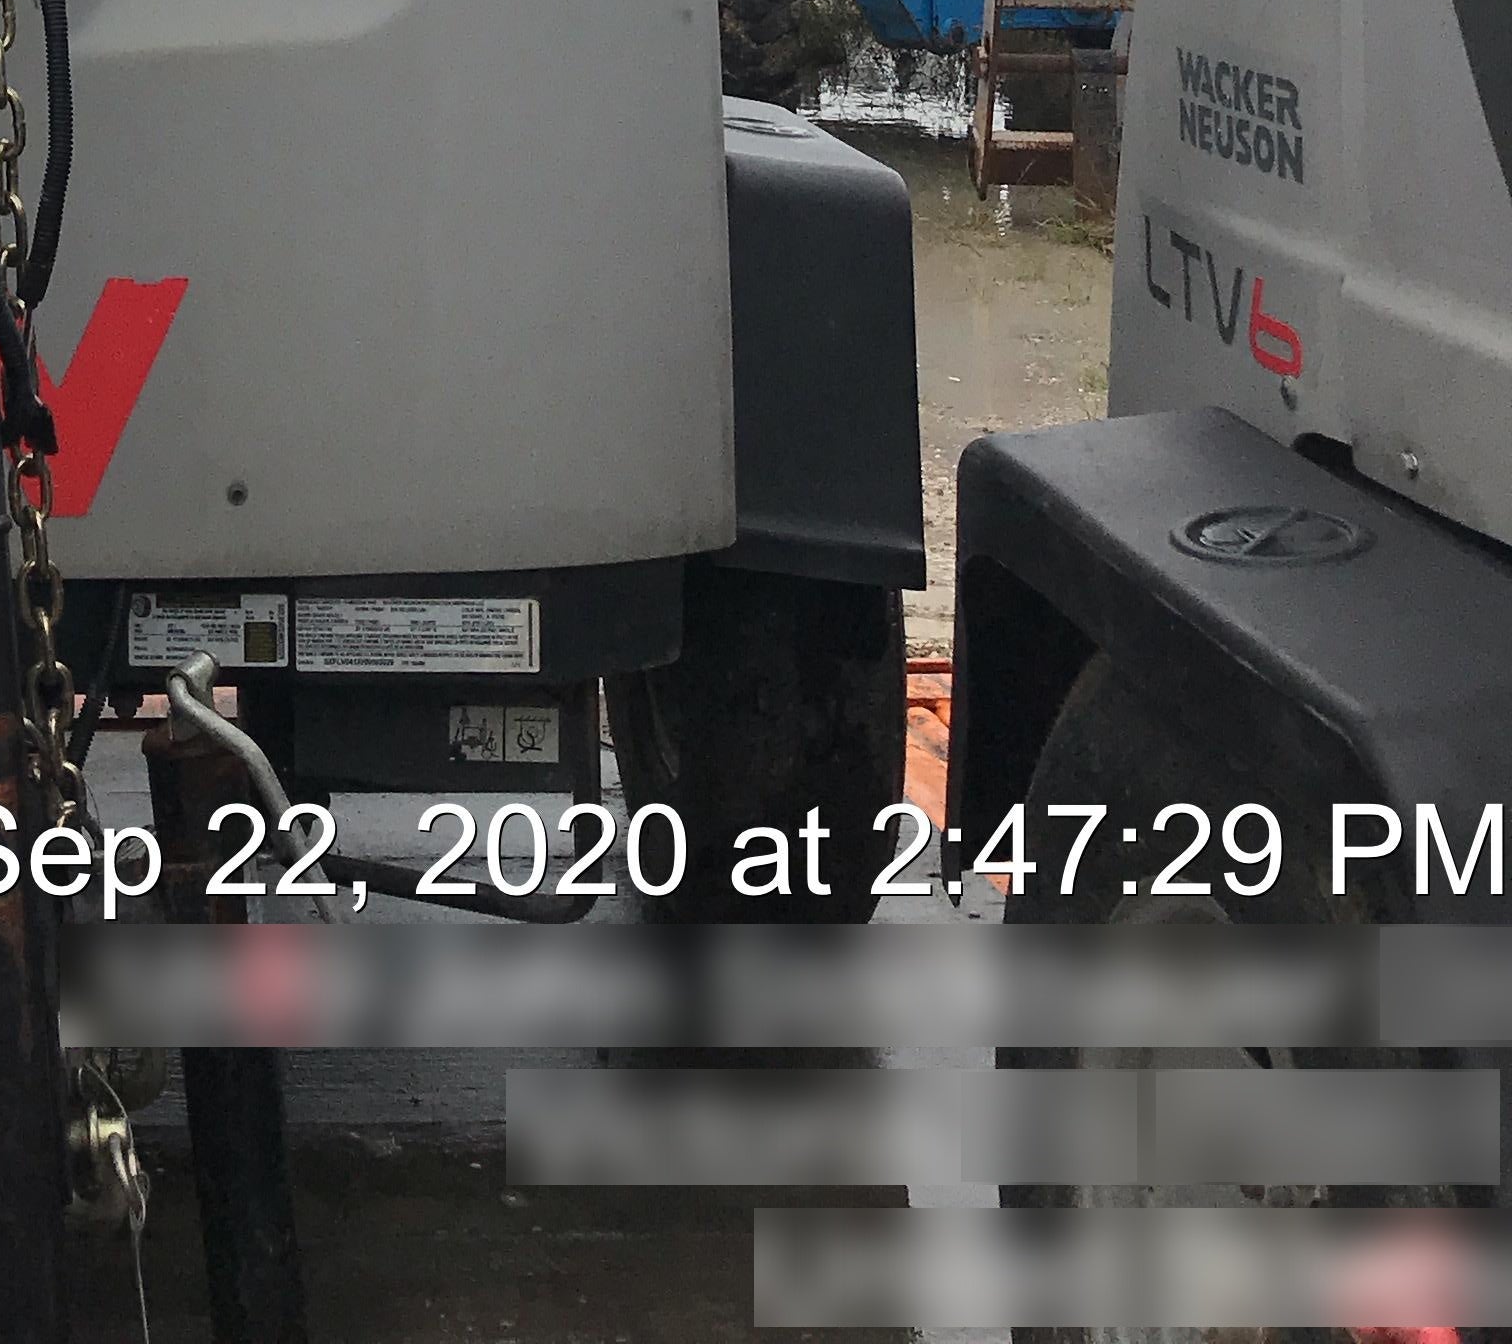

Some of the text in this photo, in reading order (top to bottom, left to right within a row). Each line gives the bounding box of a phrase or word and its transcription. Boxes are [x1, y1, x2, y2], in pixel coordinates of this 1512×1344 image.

[1176, 45, 1303, 131] WACKER
[1178, 96, 1305, 185] NEUSON
[1143, 213, 1305, 380] LTV6
